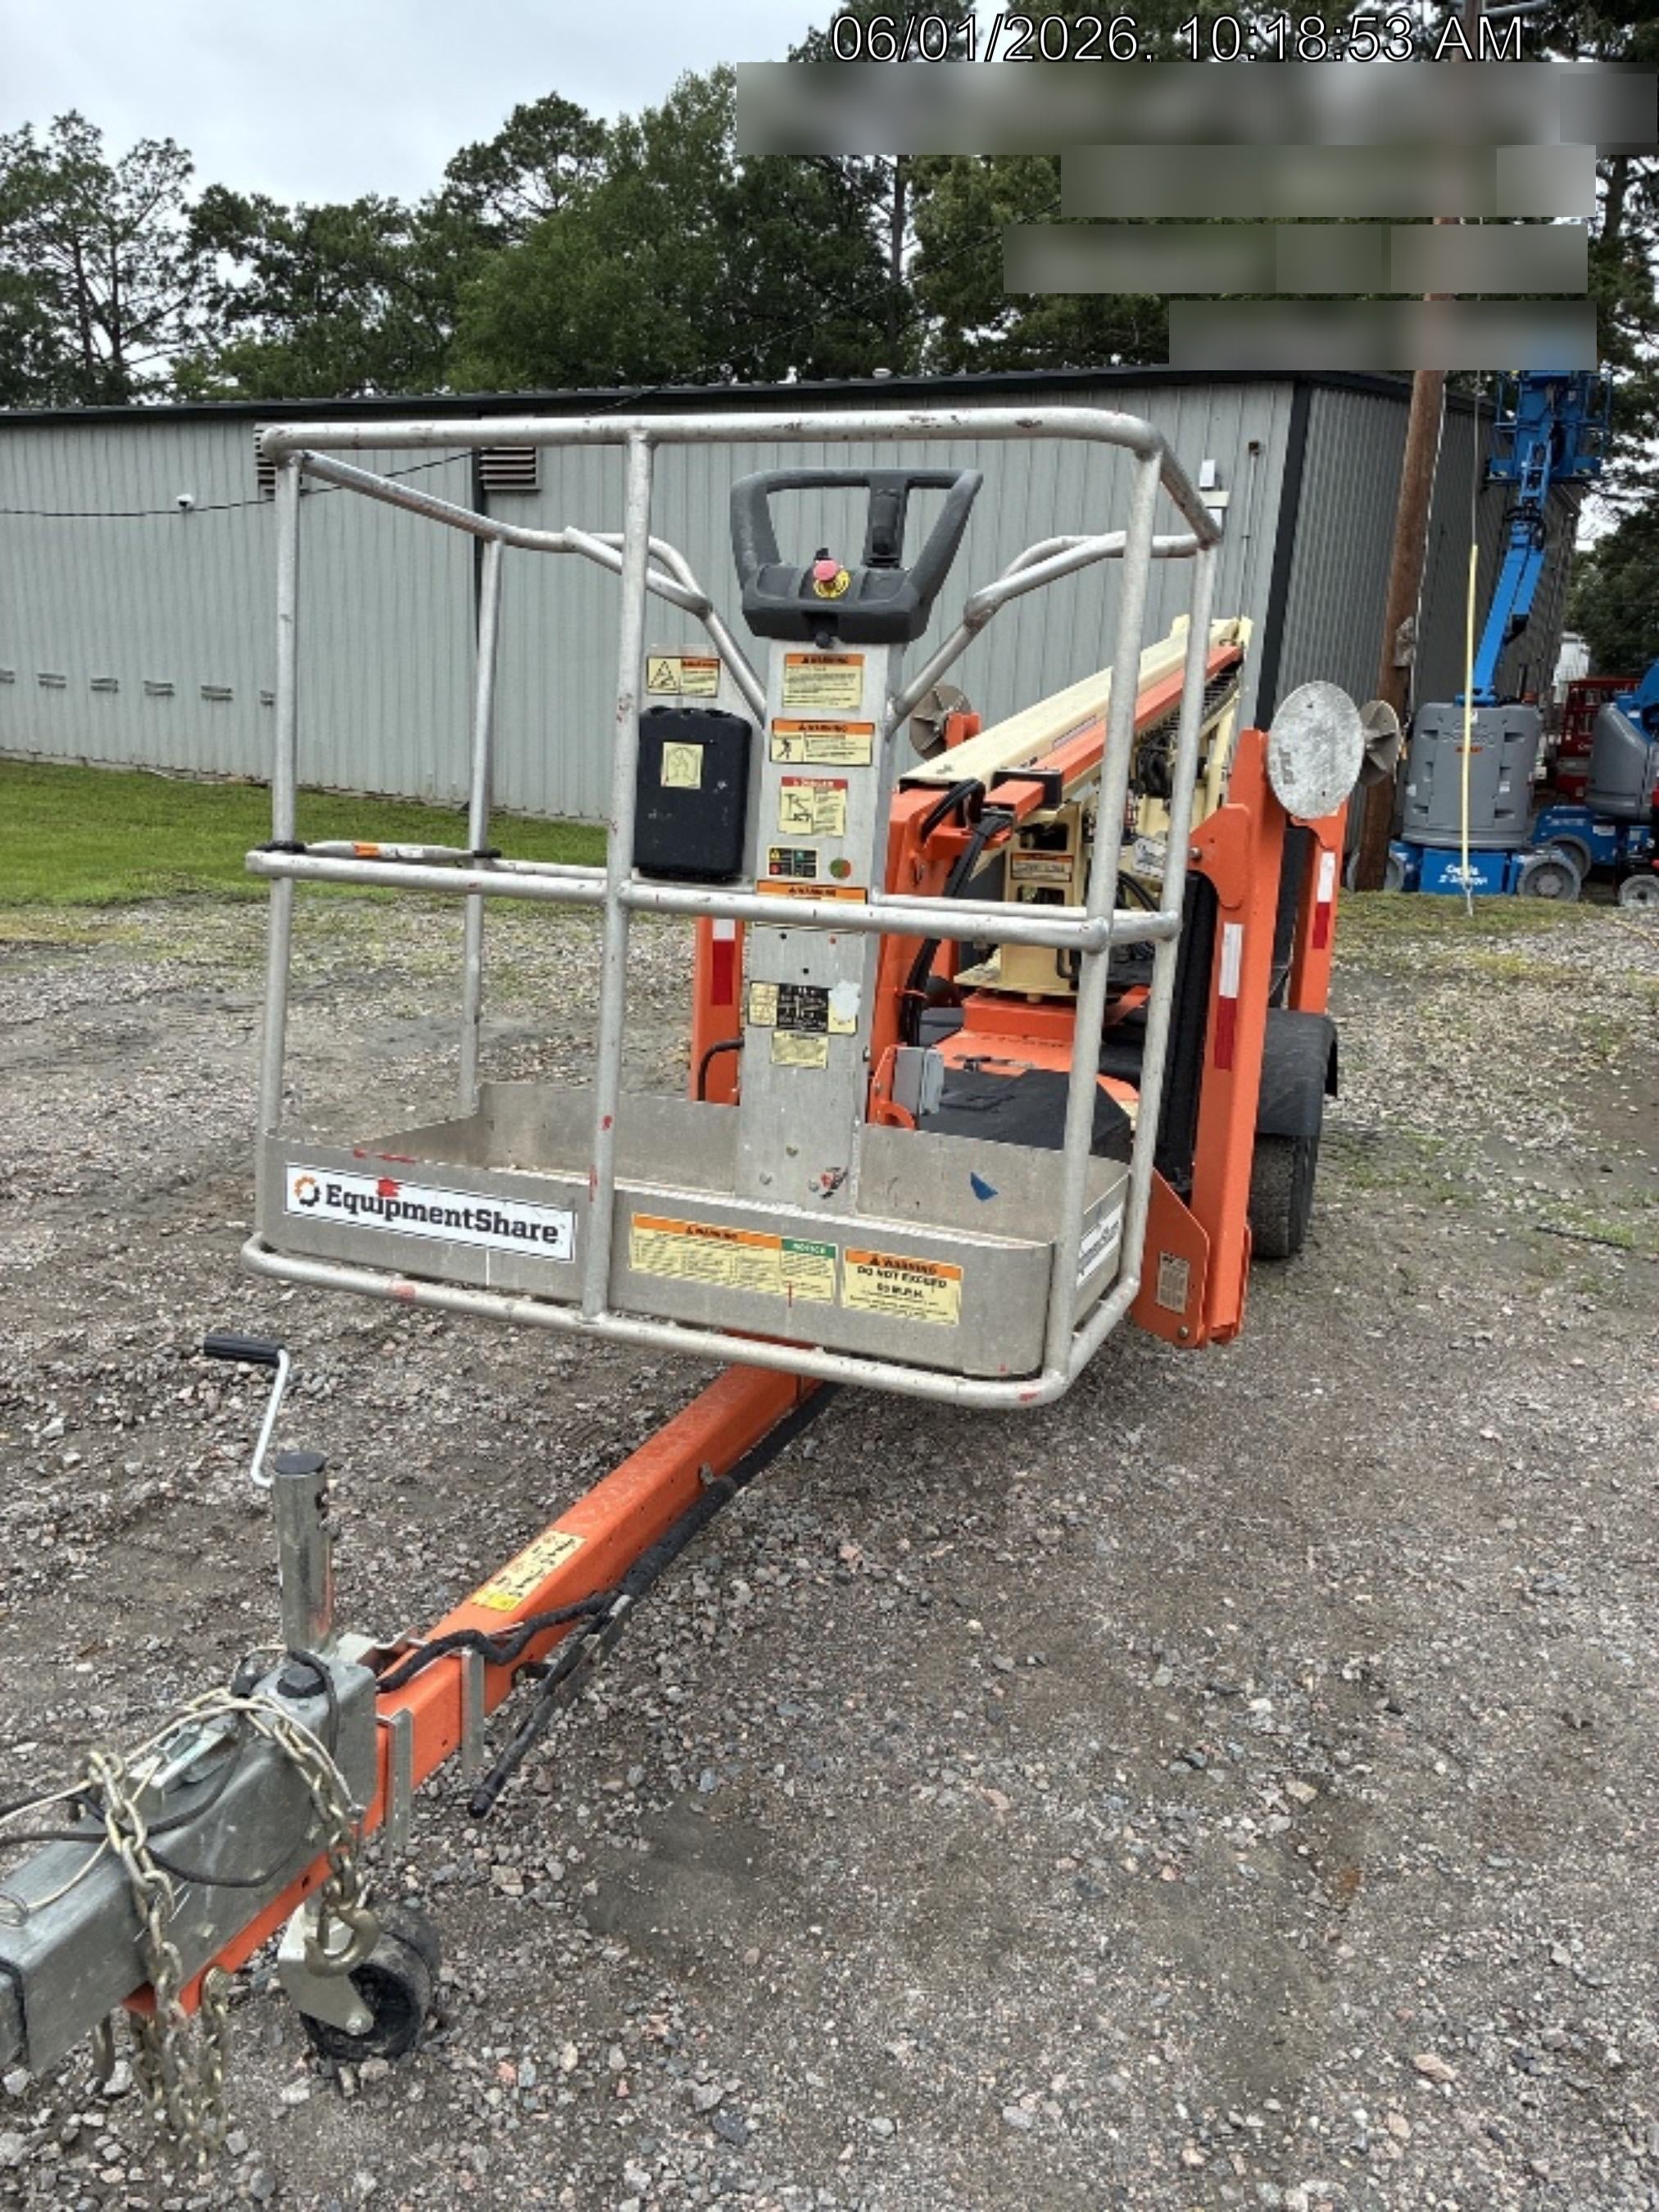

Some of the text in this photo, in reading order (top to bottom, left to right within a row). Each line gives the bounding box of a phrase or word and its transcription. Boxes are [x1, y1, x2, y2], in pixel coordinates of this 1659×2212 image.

[325, 1184, 559, 1244] EquipmentShare
[792, 1242, 827, 1255] NOTICE
[884, 1257, 937, 1276] WARNING
[857, 1266, 947, 1289] DO NOT EXCEED
